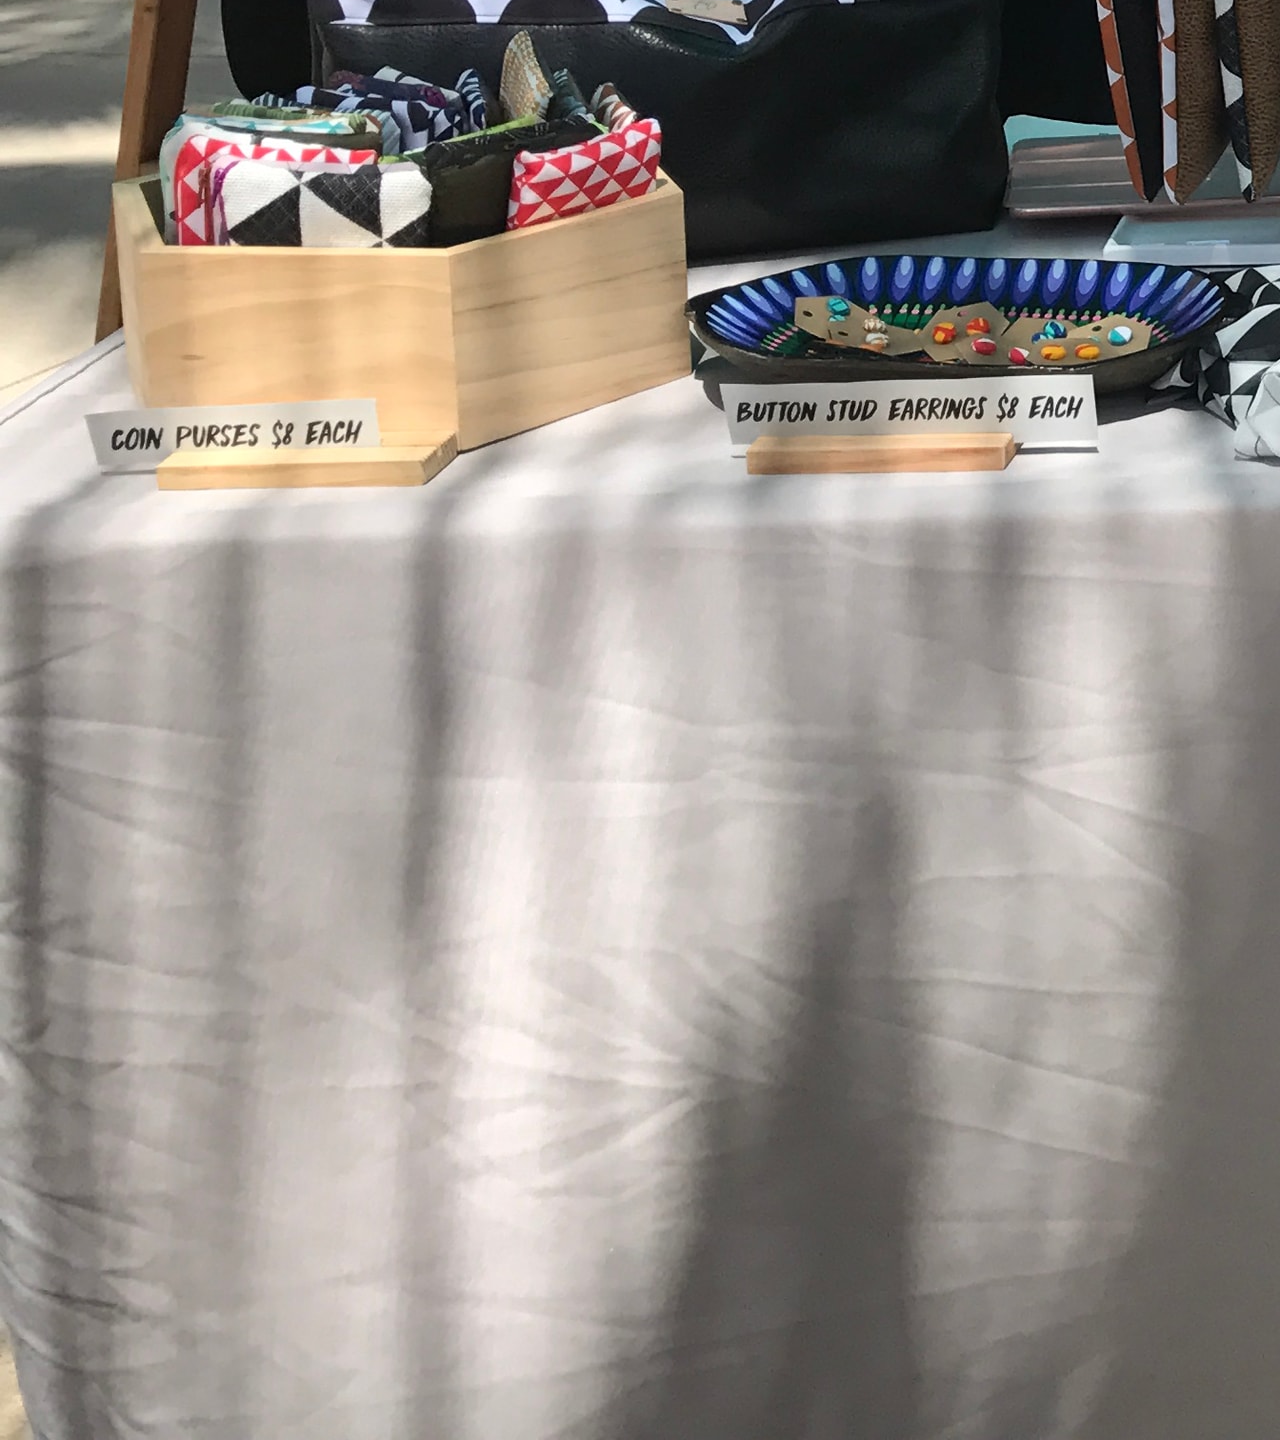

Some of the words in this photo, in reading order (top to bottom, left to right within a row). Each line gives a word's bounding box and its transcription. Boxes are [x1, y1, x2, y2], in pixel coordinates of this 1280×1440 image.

[737, 401, 817, 423] BUTTON
[826, 399, 878, 423] STUD
[888, 396, 988, 422] EARRINGS
[996, 393, 1020, 423] $8
[1028, 395, 1084, 421] EACH
[111, 427, 163, 451] COIN
[176, 424, 260, 449] PURSES
[272, 419, 295, 449] $8
[305, 419, 363, 445] EACH
